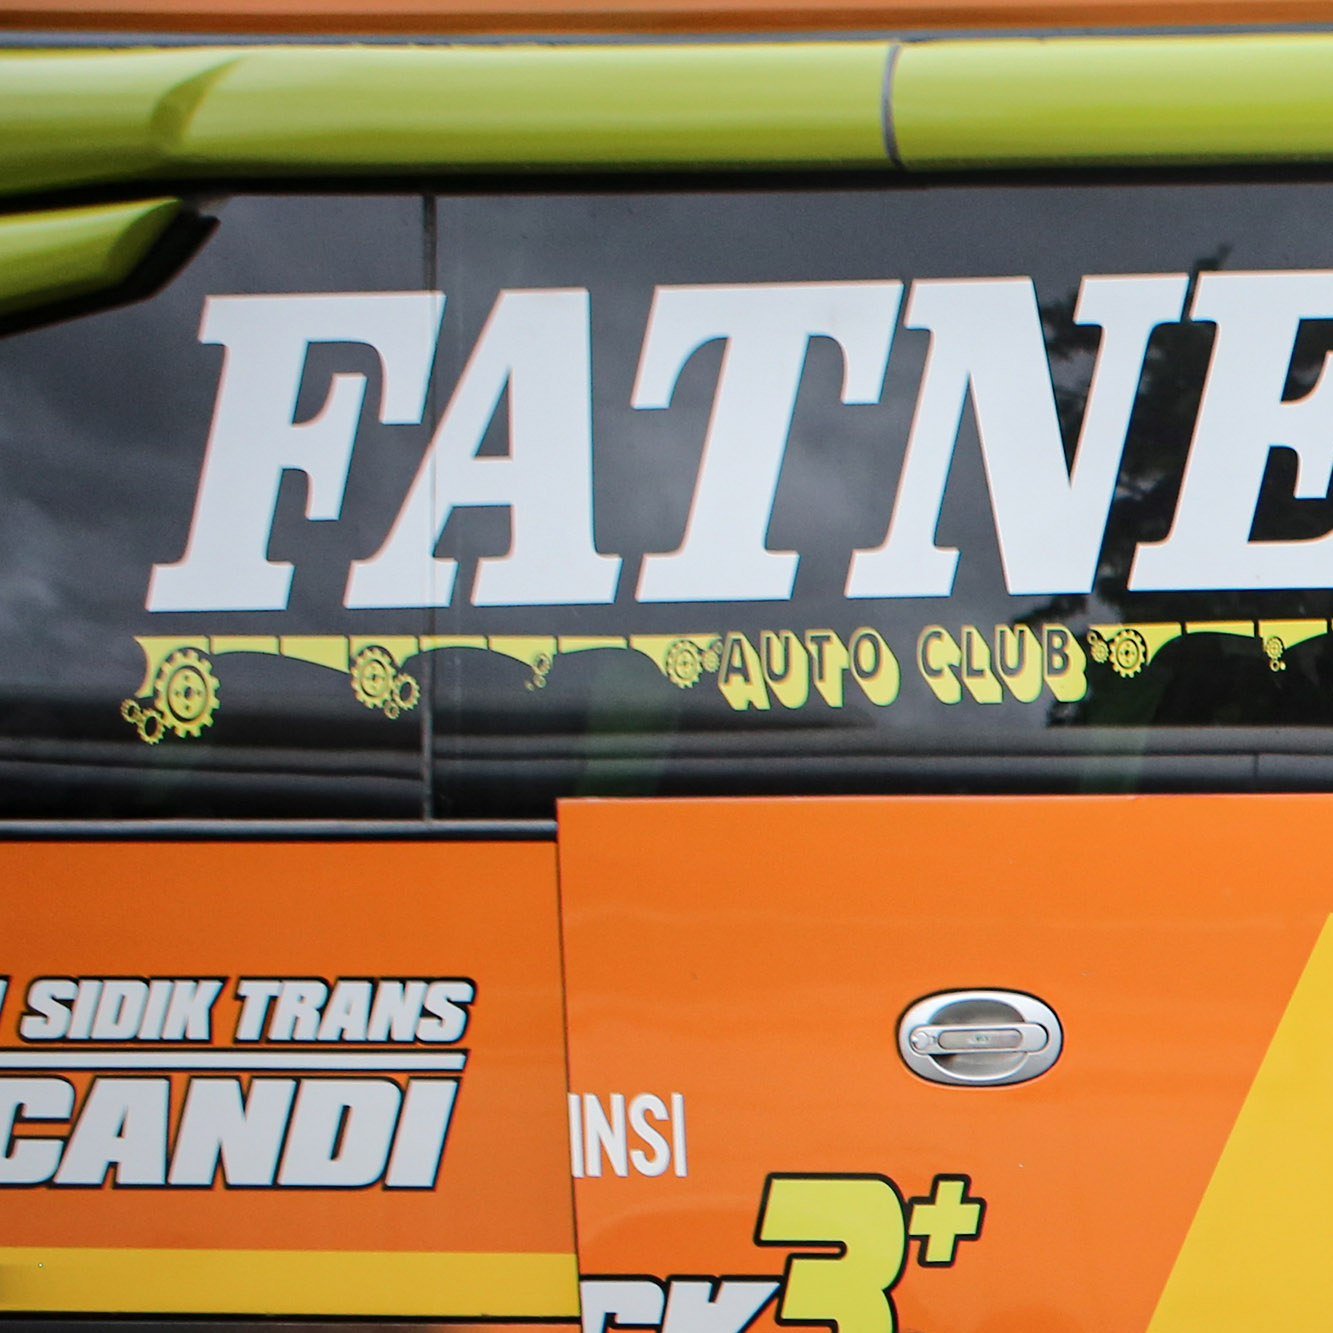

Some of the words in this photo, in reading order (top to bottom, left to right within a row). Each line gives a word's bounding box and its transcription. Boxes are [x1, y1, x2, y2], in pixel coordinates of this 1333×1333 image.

[717, 626, 900, 711] AUTO
[917, 625, 1088, 704] CLUB
[20, 977, 226, 1042] SIDIK
[233, 977, 475, 1043] TRANS
[0, 1075, 460, 1190] CANDI
[567, 1092, 687, 1178] INSI
